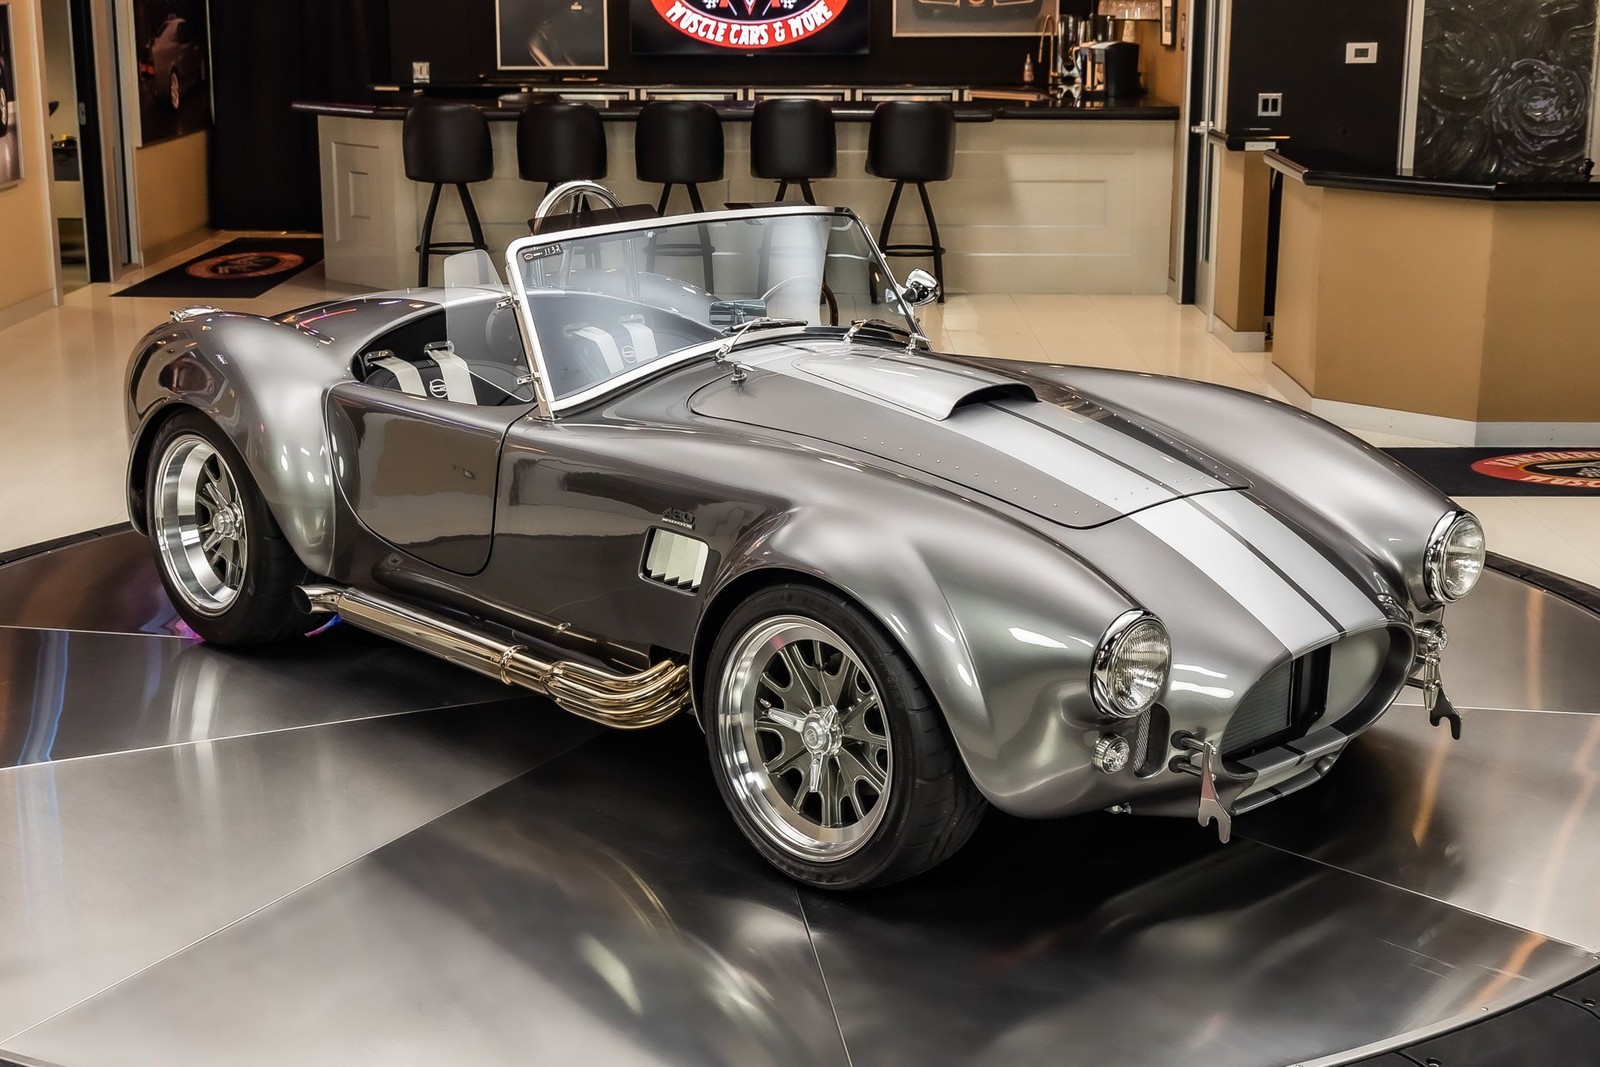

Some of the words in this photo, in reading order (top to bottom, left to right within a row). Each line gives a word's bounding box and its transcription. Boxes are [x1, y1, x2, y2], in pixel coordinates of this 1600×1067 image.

[665, 1, 727, 42] MUSCLE
[729, 23, 769, 45] CARS
[772, 21, 786, 42] &
[787, 0, 834, 38] MORE
